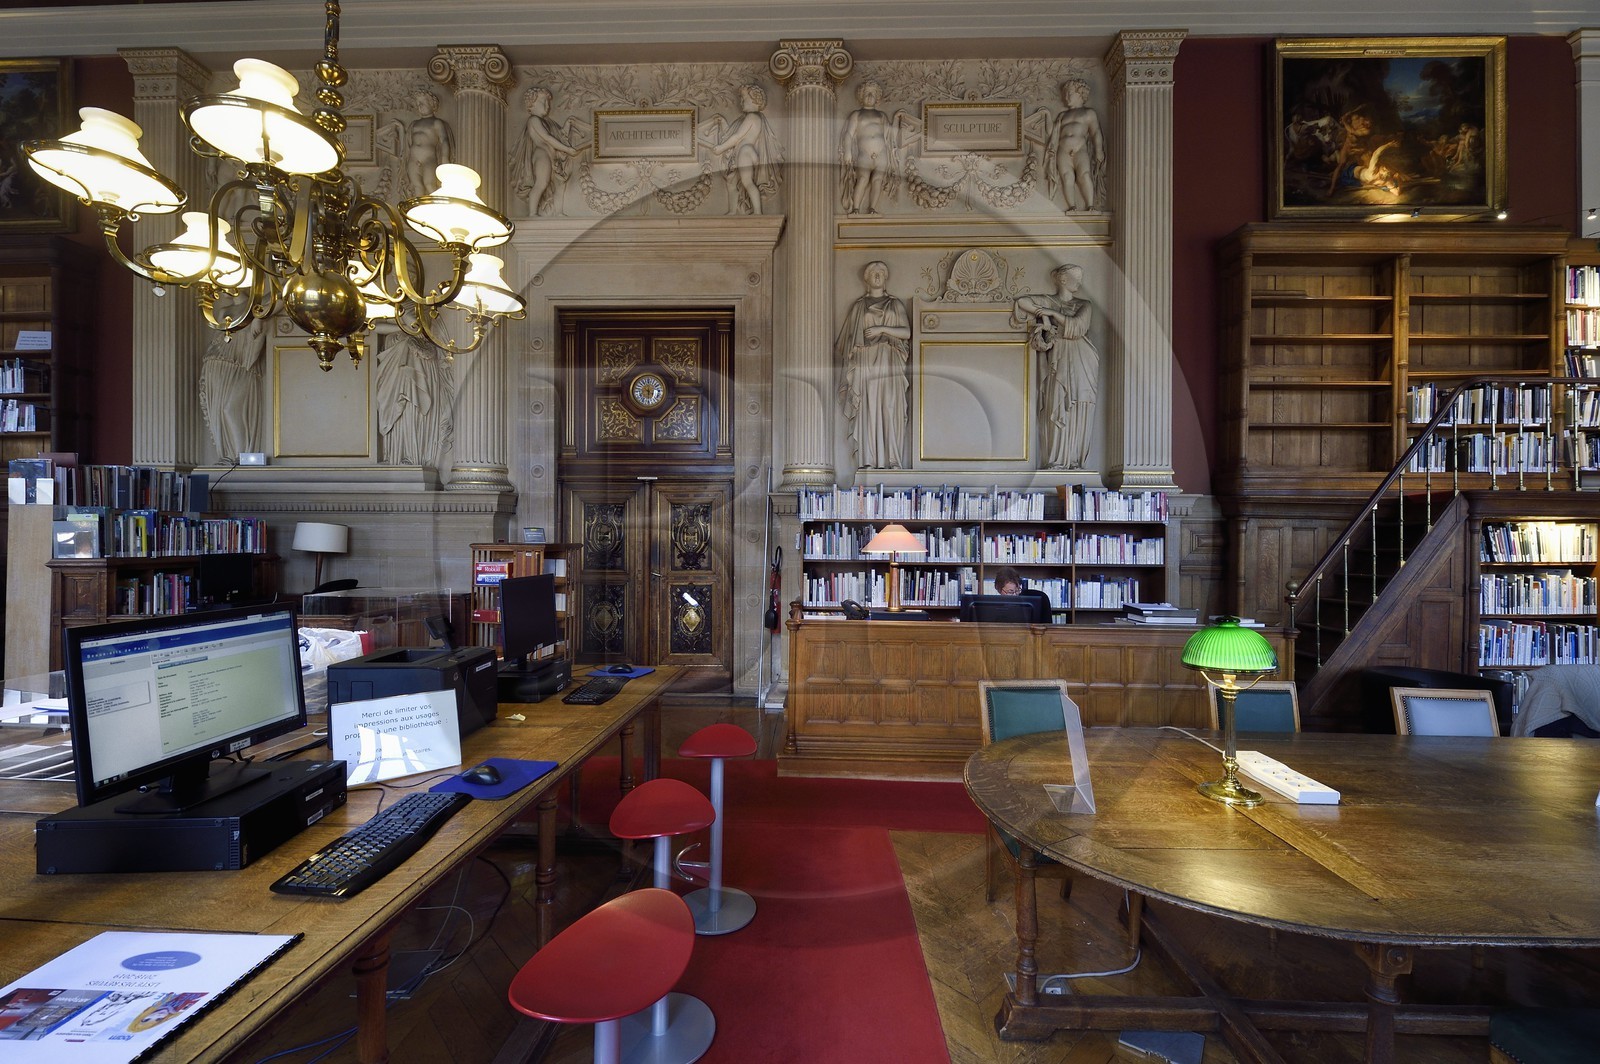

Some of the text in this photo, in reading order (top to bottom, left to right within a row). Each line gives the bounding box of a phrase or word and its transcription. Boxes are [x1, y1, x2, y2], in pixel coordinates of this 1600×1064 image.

[943, 122, 1002, 133] SCULPTURE
[608, 129, 680, 140] ARCHITECTURE
[361, 710, 382, 718] Merci
[395, 705, 417, 714] limiter
[353, 717, 398, 729] impressions
[415, 711, 440, 720] usages
[376, 727, 381, 735] à
[383, 726, 397, 734] une
[399, 719, 442, 731] bibliothèque
